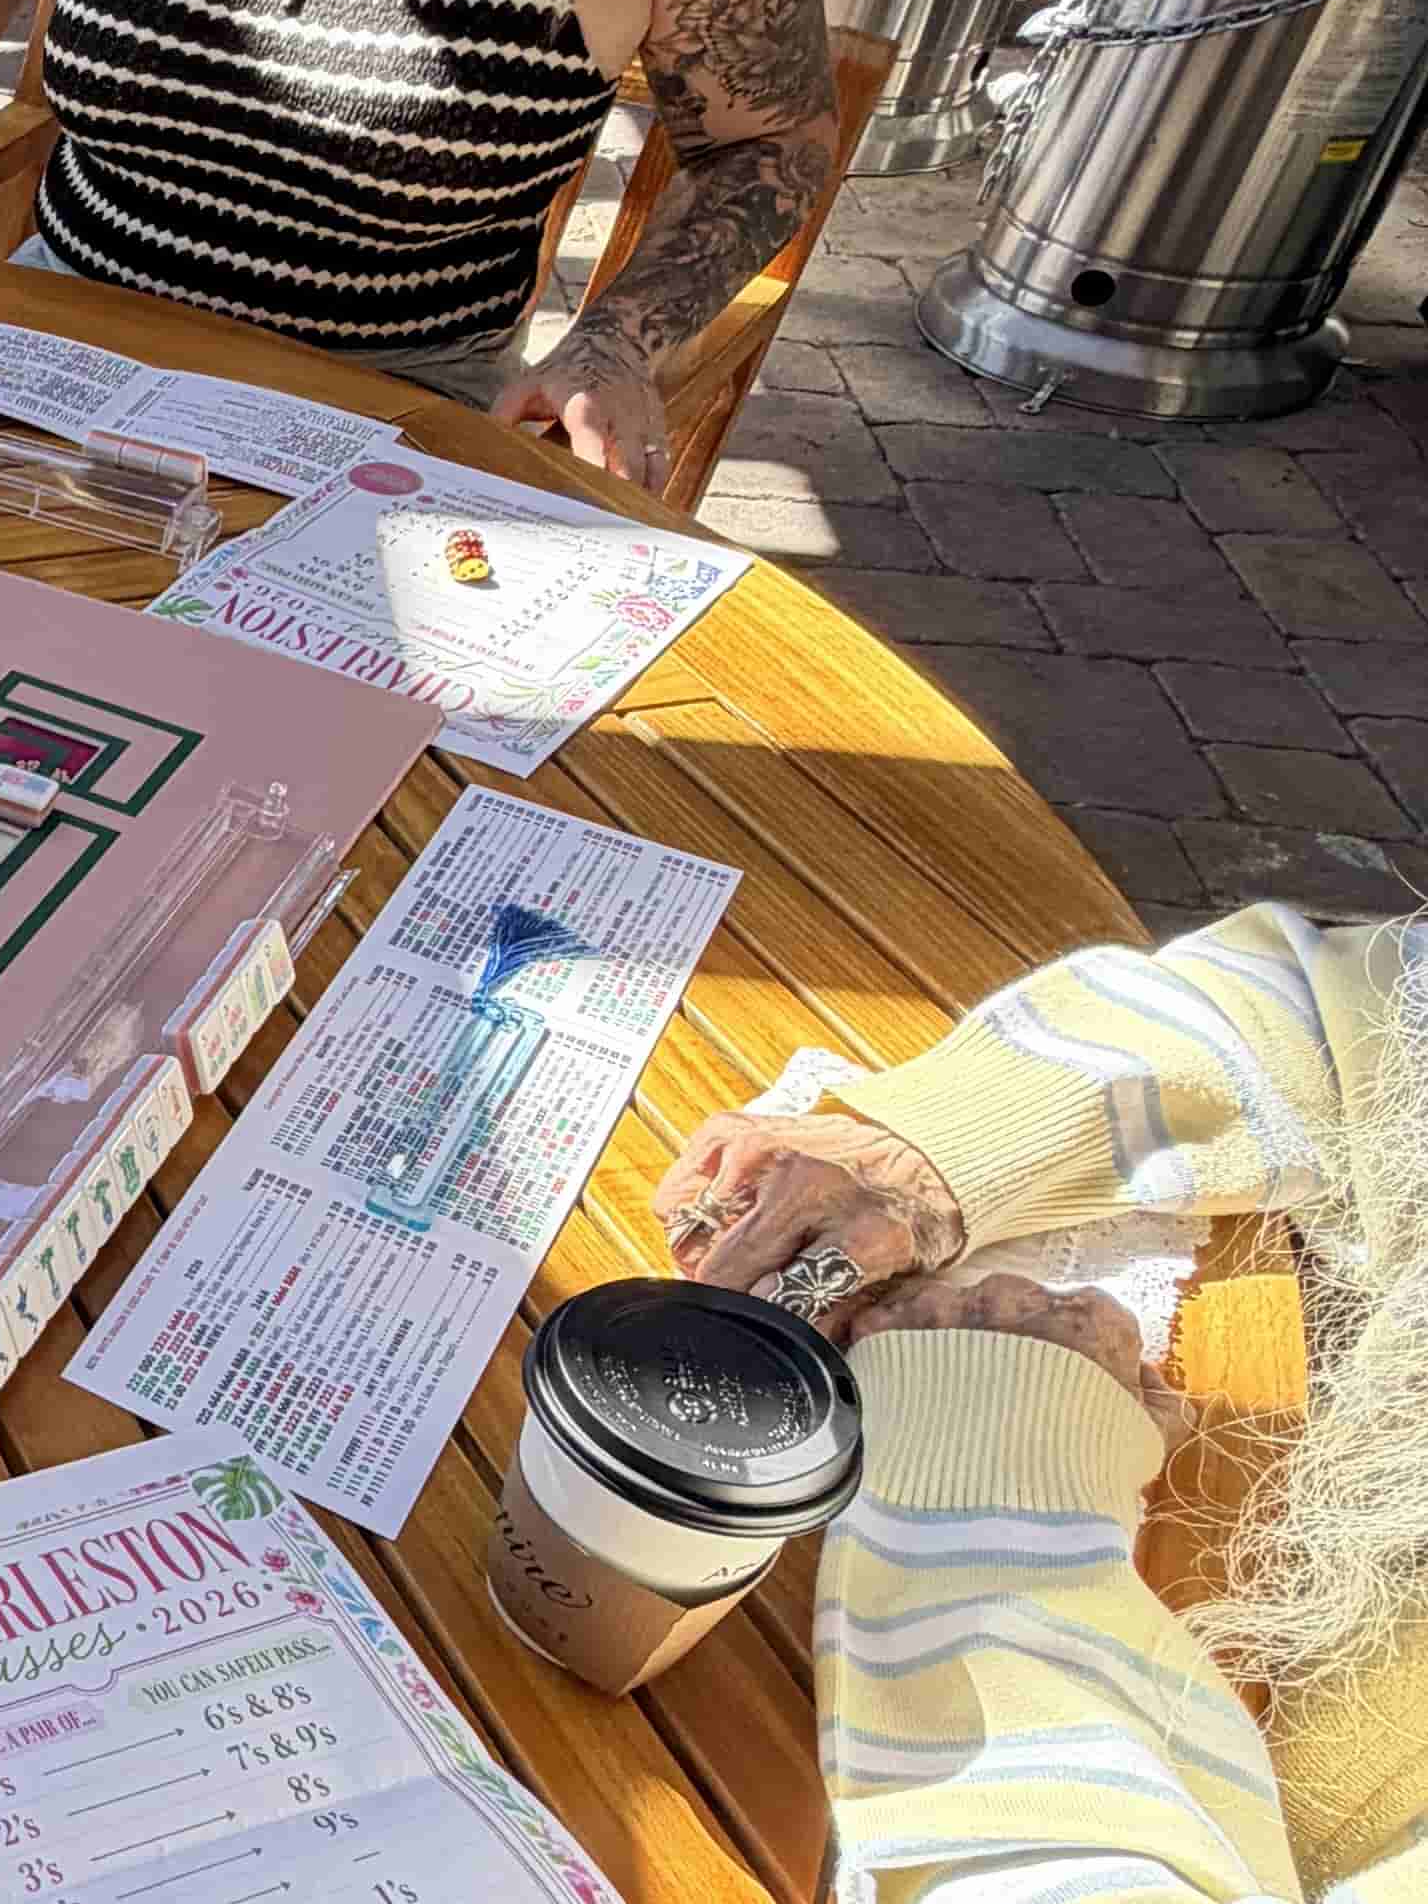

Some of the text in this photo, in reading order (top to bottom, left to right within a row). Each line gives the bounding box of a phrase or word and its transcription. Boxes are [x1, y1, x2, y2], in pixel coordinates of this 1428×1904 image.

[218, 593, 476, 712] CHARLESTON
[152, 1580, 261, 1636] 2026
[142, 1677, 181, 1706] YOU
[179, 1666, 215, 1694] CAN
[216, 1648, 279, 1688] SAFELY
[204, 1682, 312, 1731] 6's & 8's
[4, 1727, 22, 1750] A
[18, 1716, 58, 1745] PAIR
[227, 1722, 337, 1770] 7's & 9's
[287, 1772, 331, 1803] 8's
[313, 1810, 359, 1836] 9's
[18, 1858, 63, 1892] 3's
